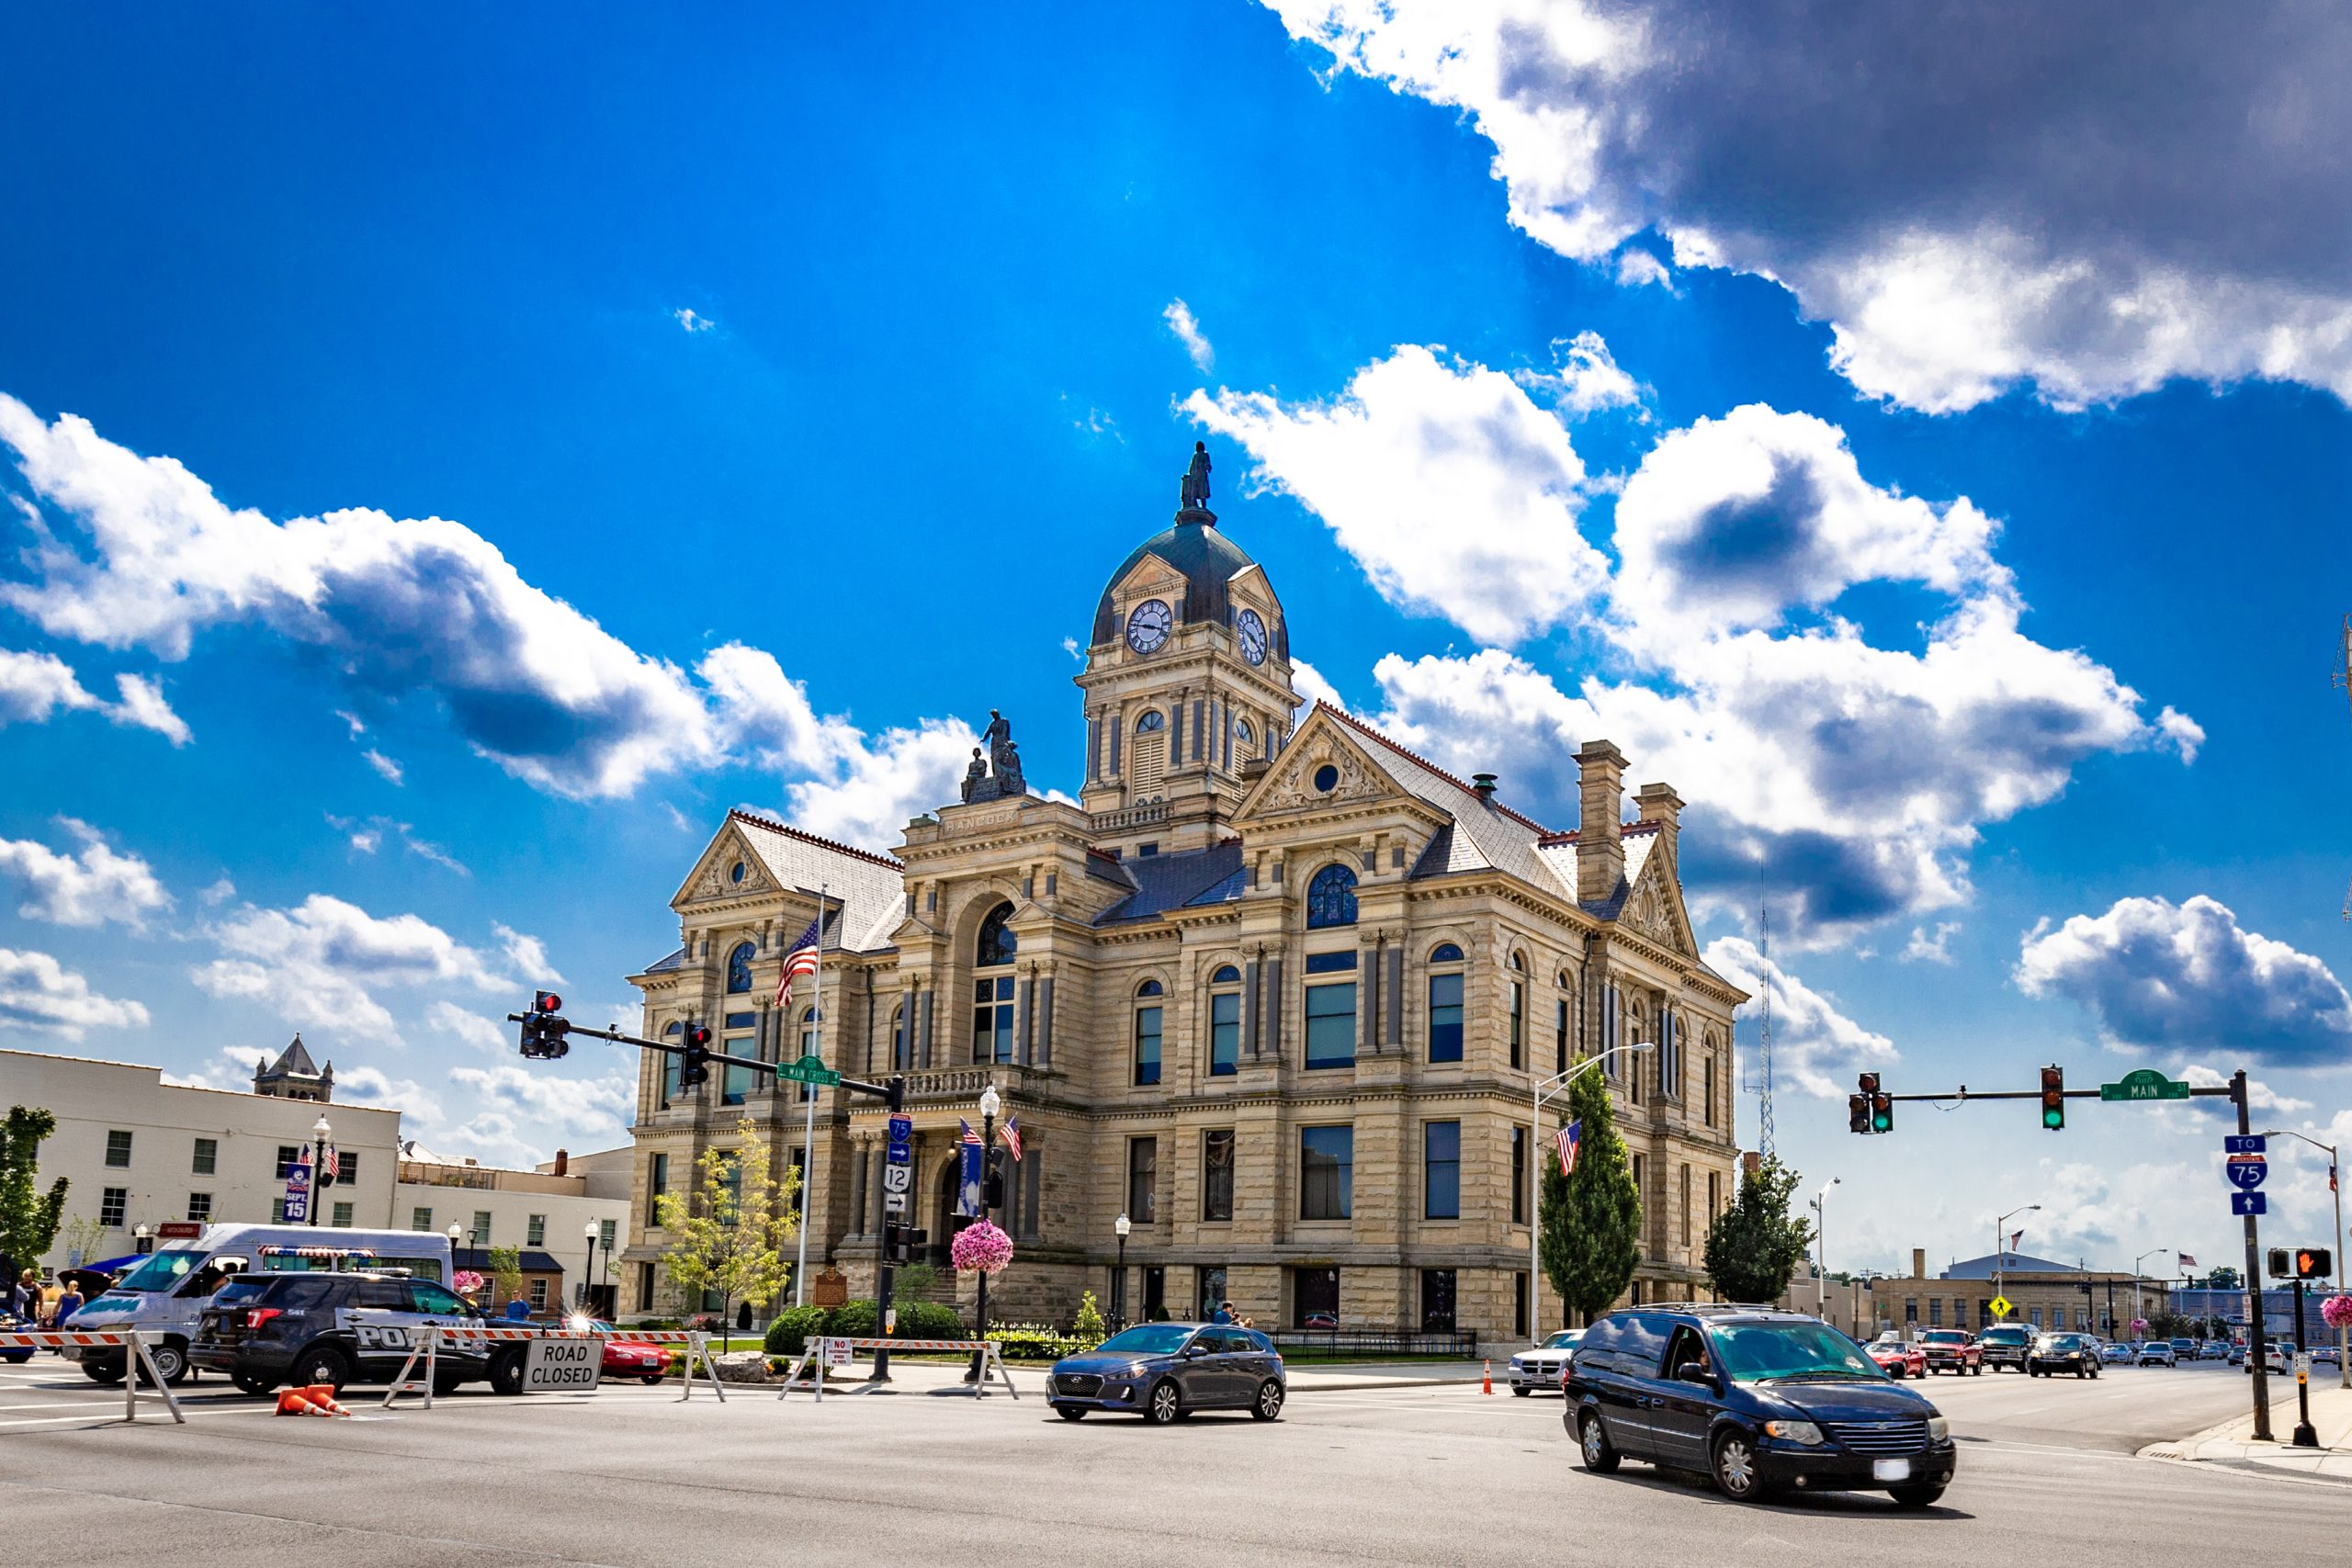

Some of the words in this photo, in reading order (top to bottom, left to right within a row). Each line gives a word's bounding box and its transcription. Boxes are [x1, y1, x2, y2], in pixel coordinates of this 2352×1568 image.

[944, 809, 1017, 832] HANCOCK
[788, 1066, 806, 1081] MAIN
[808, 1069, 830, 1084] CROSS
[2103, 1085, 2109, 1095] S
[2131, 1084, 2158, 1099] MAIN
[2177, 1083, 2188, 1092] ST
[892, 1122, 908, 1136] 75
[2235, 1139, 2256, 1149] TO
[888, 1169, 906, 1187] 12
[2233, 1166, 2261, 1182] 75
[286, 1192, 308, 1202] SEPT.
[286, 1201, 305, 1218] 15
[833, 1340, 846, 1348] NO
[543, 1346, 588, 1362] ROAD
[531, 1367, 593, 1384] CLOSED
